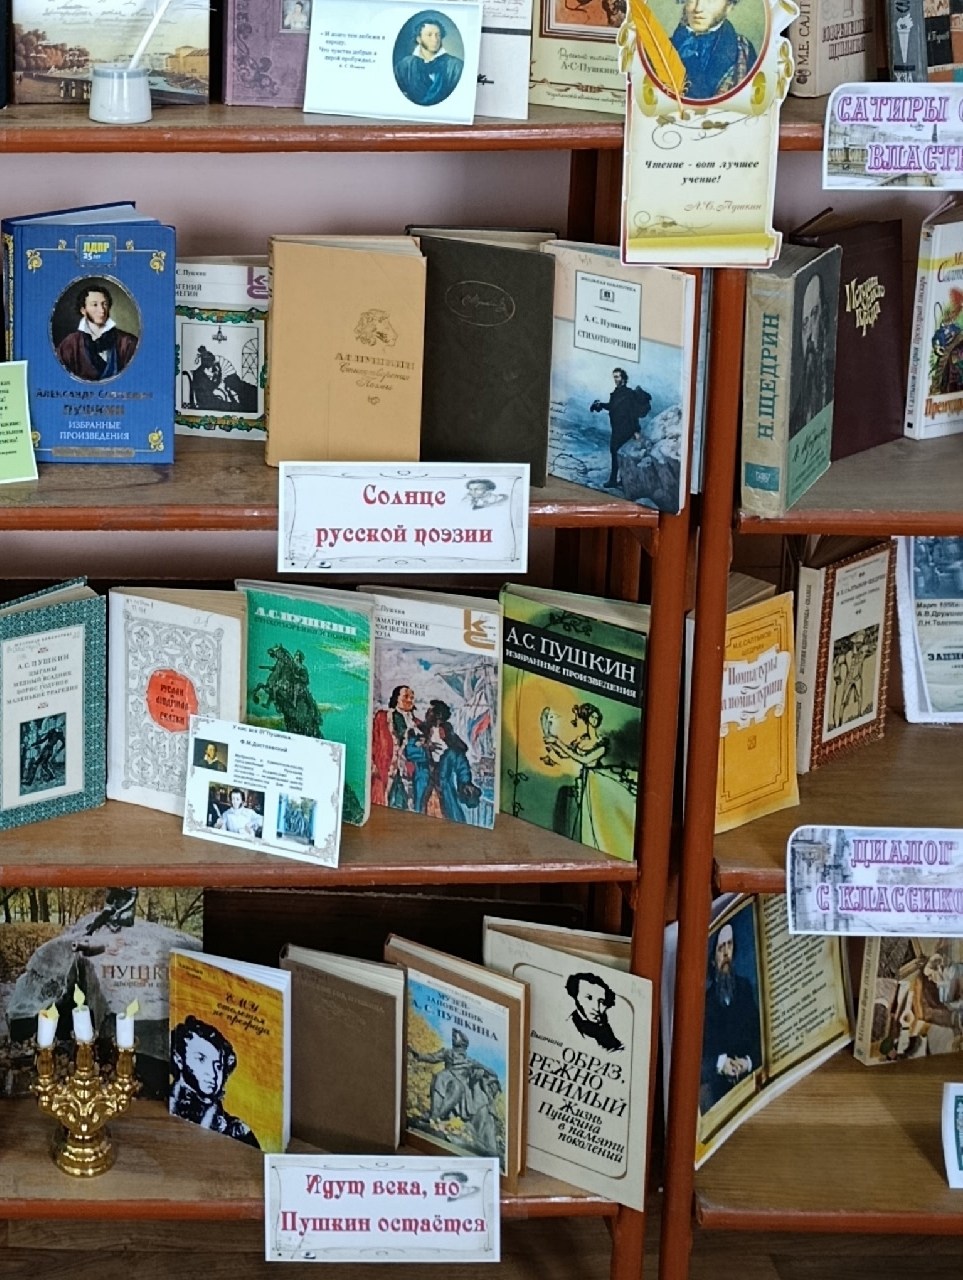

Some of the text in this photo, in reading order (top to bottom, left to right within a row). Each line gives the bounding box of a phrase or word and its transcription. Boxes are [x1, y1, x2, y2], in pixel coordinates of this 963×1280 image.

[837, 96, 950, 122] САТИРЫ
[645, 159, 759, 170] Чтение вот лучшее
[682, 173, 721, 185] учение!
[83, 241, 110, 253] ЛДПР
[601, 319, 633, 332] Пушкин
[577, 328, 637, 352] СТИХОТВОРЕНИЯ
[338, 362, 411, 382] Стихотворения
[758, 312, 780, 441] Н. ЩЕДРИН
[59, 431, 129, 441] ПРОИЗВЕДЕНИЯ
[68, 420, 121, 430] ИЗБРАННЫЕ
[363, 484, 447, 507] Солнце
[315, 524, 493, 548] русской поэзии
[280, 612, 357, 636] ПУШКИН
[28, 666, 57, 677] ЦЫГАНЫ
[31, 654, 69, 667] ПУШКИН
[540, 638, 635, 683] ПУШКИН
[728, 656, 778, 685] Помпадуры
[13, 670, 72, 687] МЕДНЫЙ ВСАДНИК
[505, 649, 637, 699] ИЗБРАННЫЕ ПРОИЗВЕДЕНИЯ
[6, 685, 78, 704] МАЛЕНЬКИЕ ТРАГЕДИИ
[16, 679, 68, 695] БОРИС ГОДУНОВ
[851, 839, 954, 868] ДИАЛОГ
[816, 885, 830, 911] С
[212, 1009, 224, 1018] не
[436, 1007, 499, 1042] ПУШКИНА
[562, 1047, 625, 1084] ОБРАЗ,
[537, 1101, 601, 1134] Пушкина
[560, 1099, 603, 1125] Жизнь
[557, 1132, 623, 1164] поколений
[568, 1126, 625, 1153] памяти
[305, 1173, 460, 1199] Идут века, но
[280, 1210, 487, 1235] Пушкин остаётся
